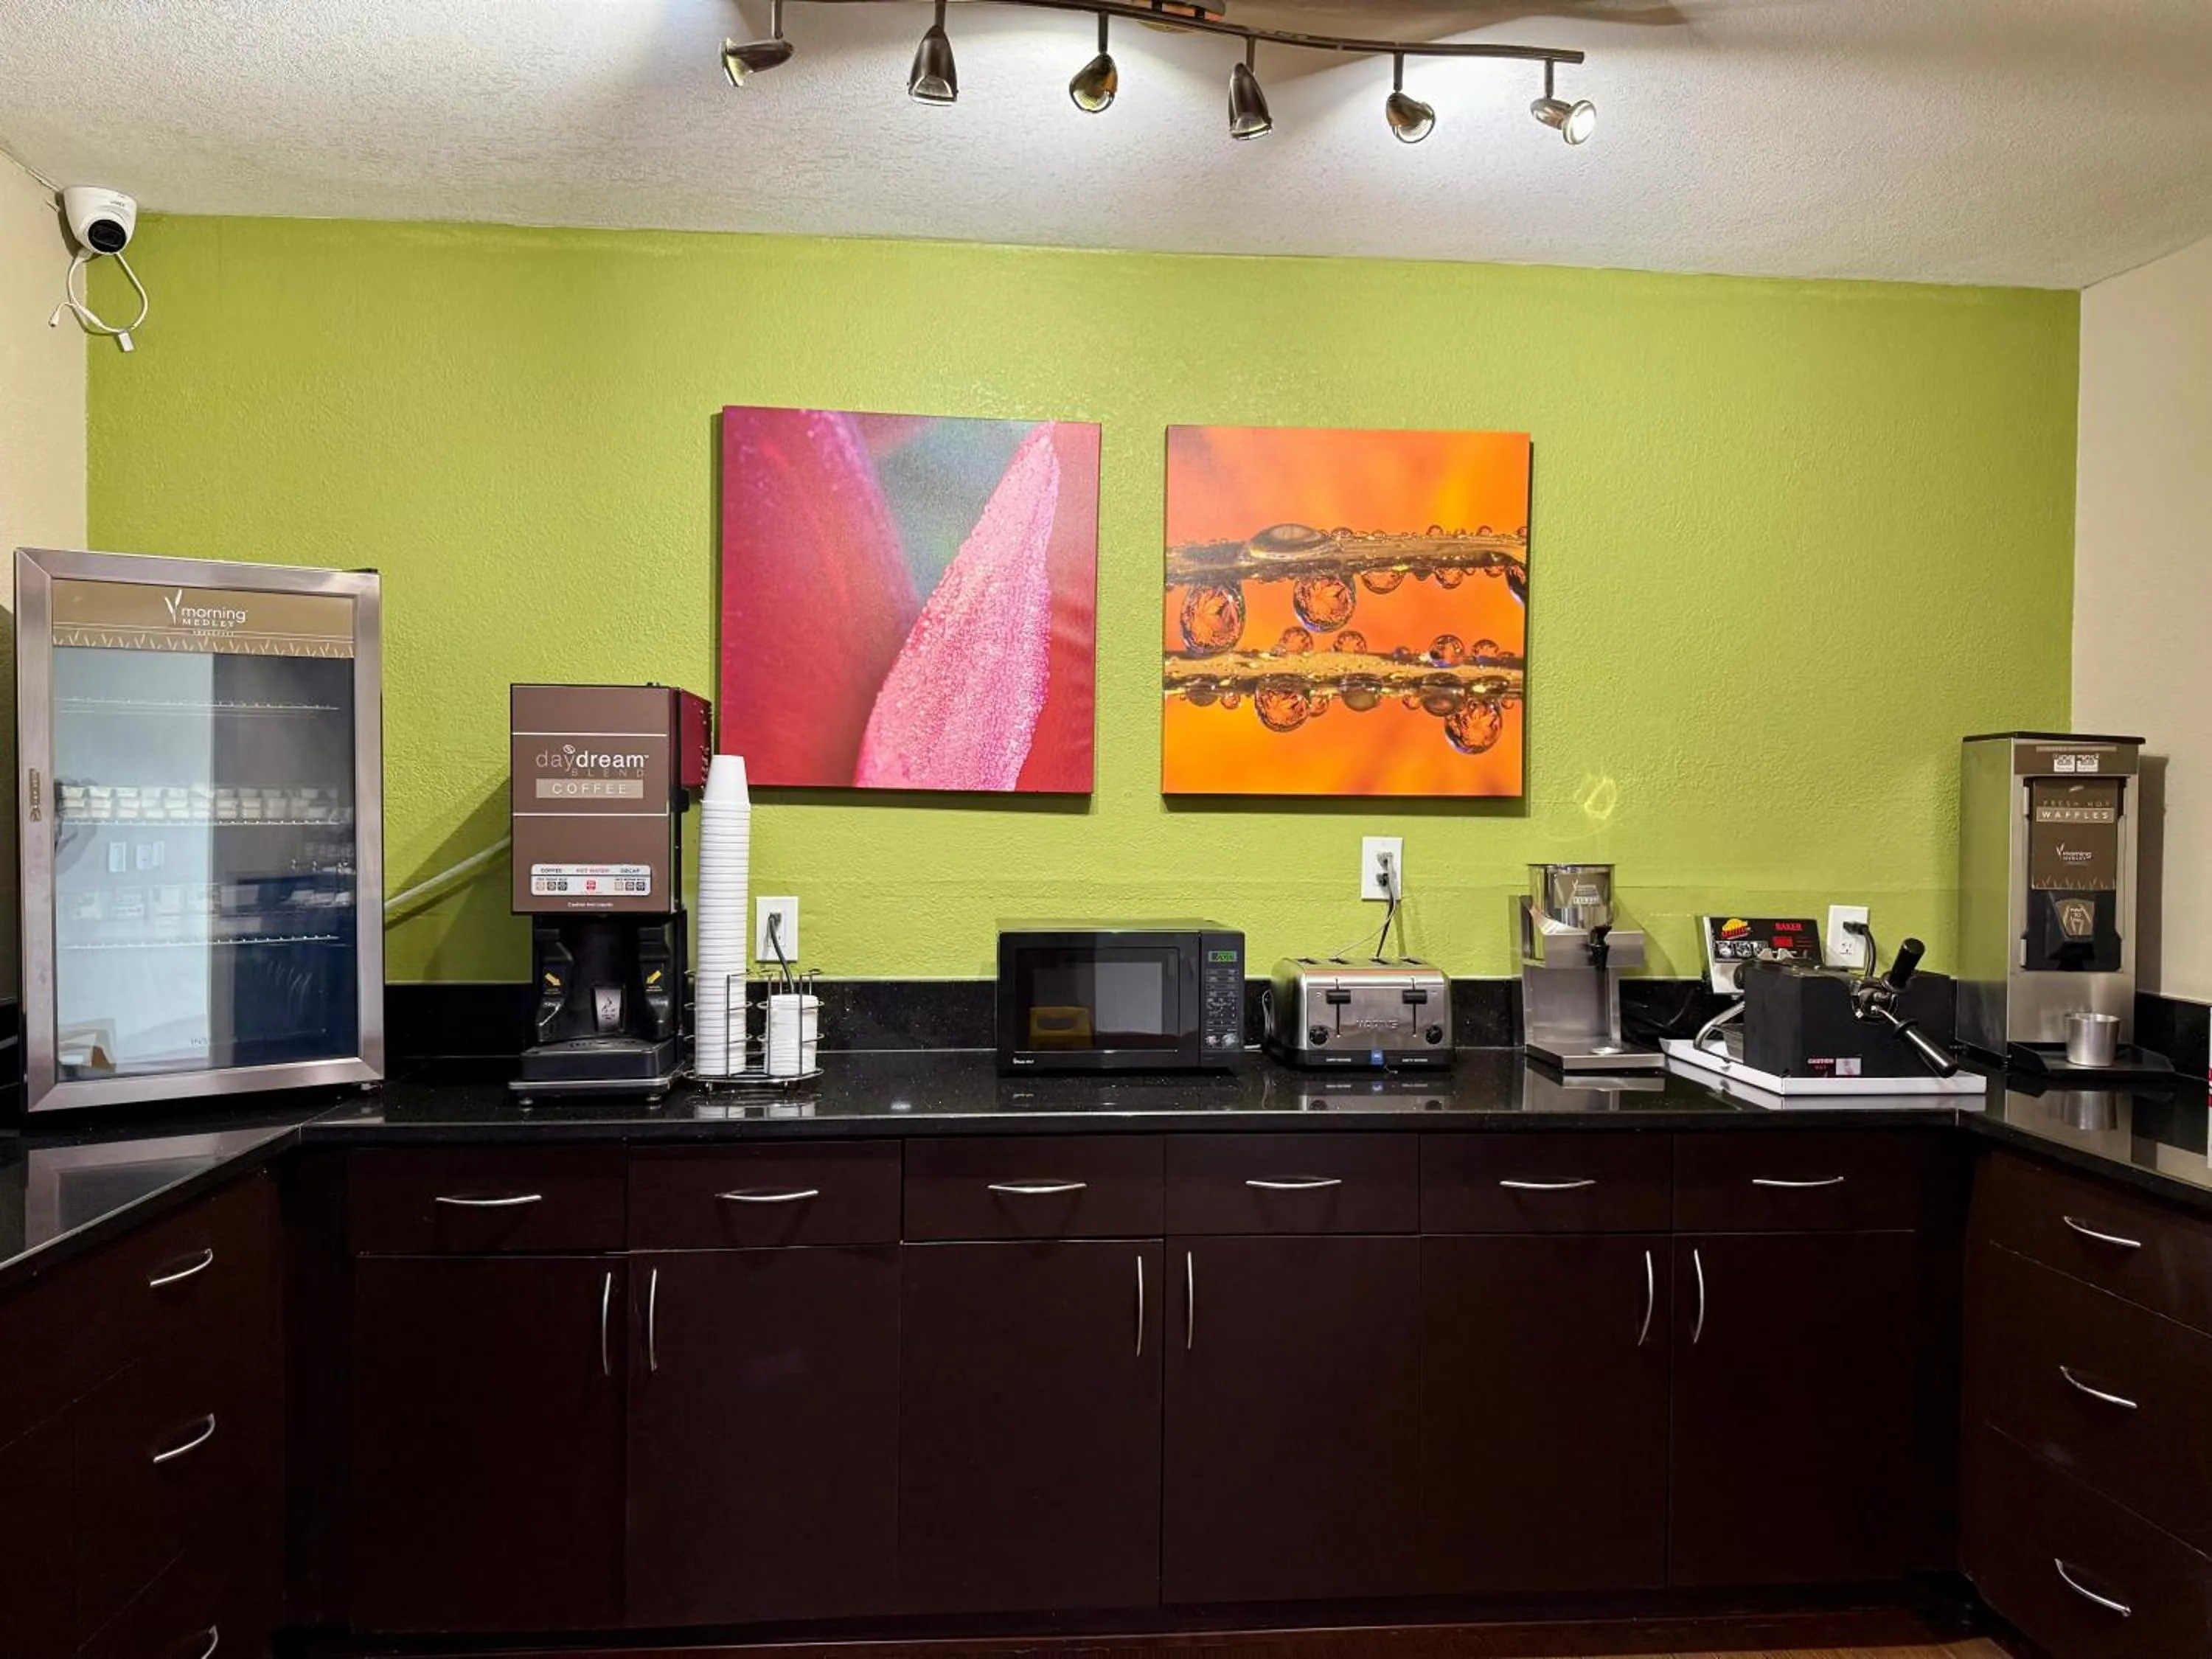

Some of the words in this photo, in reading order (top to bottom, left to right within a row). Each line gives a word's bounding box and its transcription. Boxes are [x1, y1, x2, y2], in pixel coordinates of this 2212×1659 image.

[181, 607, 246, 624] morning
[182, 619, 235, 627] MEDLEY
[535, 750, 644, 772] daydream
[571, 768, 645, 778] BLEND
[552, 782, 627, 795] COFFEE
[2041, 811, 2109, 820] WAFFLES
